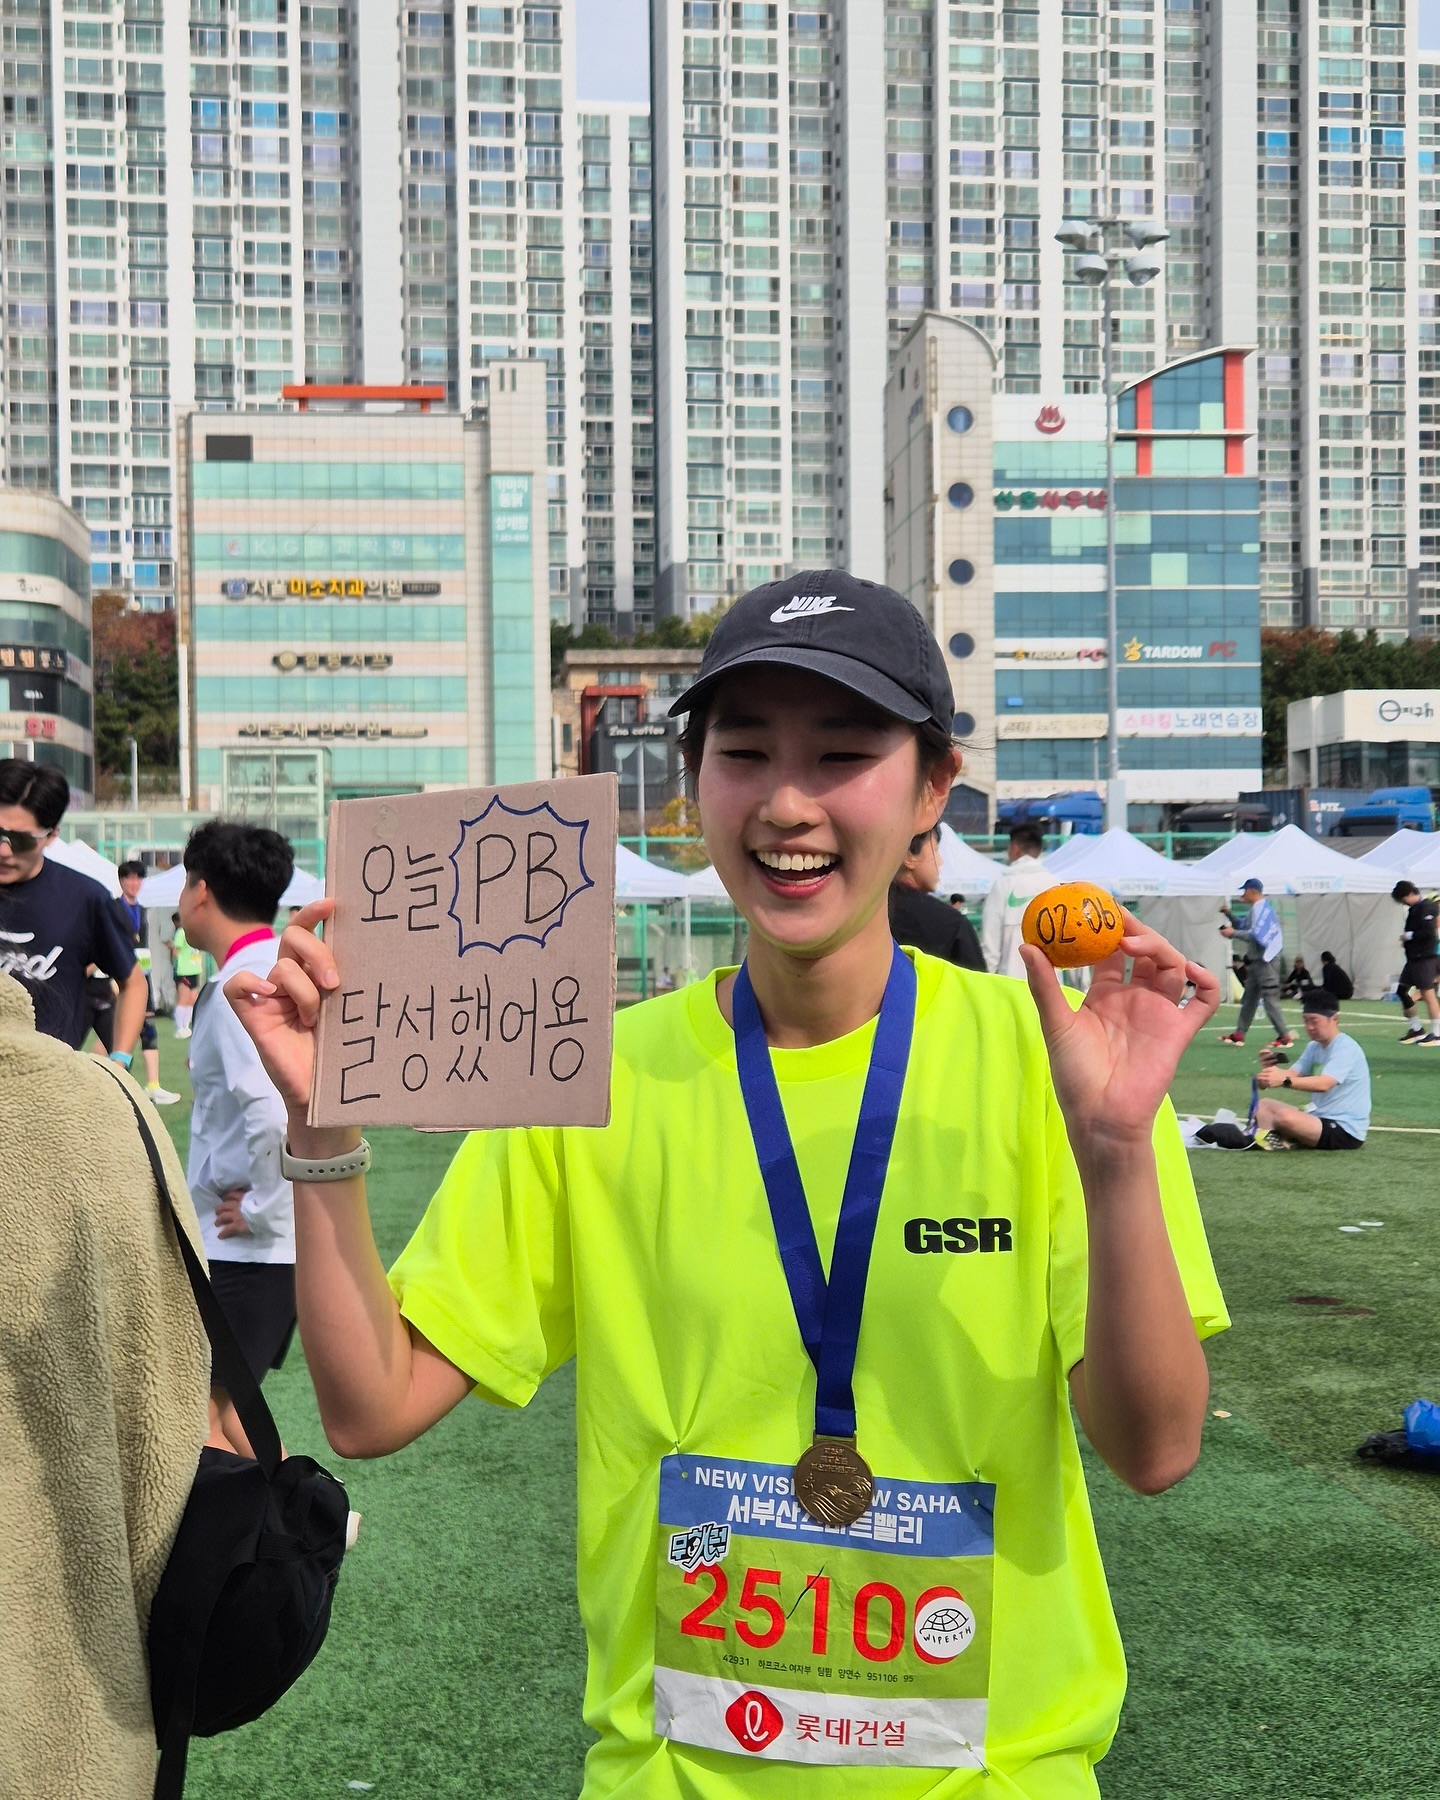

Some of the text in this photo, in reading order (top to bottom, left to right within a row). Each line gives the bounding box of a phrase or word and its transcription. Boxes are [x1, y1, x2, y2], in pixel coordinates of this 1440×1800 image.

[784, 596, 837, 611] NIKE
[1208, 641, 1236, 658] PC
[361, 831, 568, 931] 오늘 PB
[340, 974, 589, 1104] 달성했어용
[904, 1218, 1013, 1254] GSR
[694, 1466, 748, 1491] NEW
[751, 1473, 796, 1496] VISI
[896, 1491, 962, 1515] SAHA
[726, 1494, 923, 1545] 서부산스트밸리
[923, 1626, 972, 1645] WIPERTH
[722, 1654, 750, 1667] 42931
[867, 1672, 898, 1683] 951106
[903, 1674, 914, 1683] 95
[795, 1713, 906, 1747] 롯데건설
